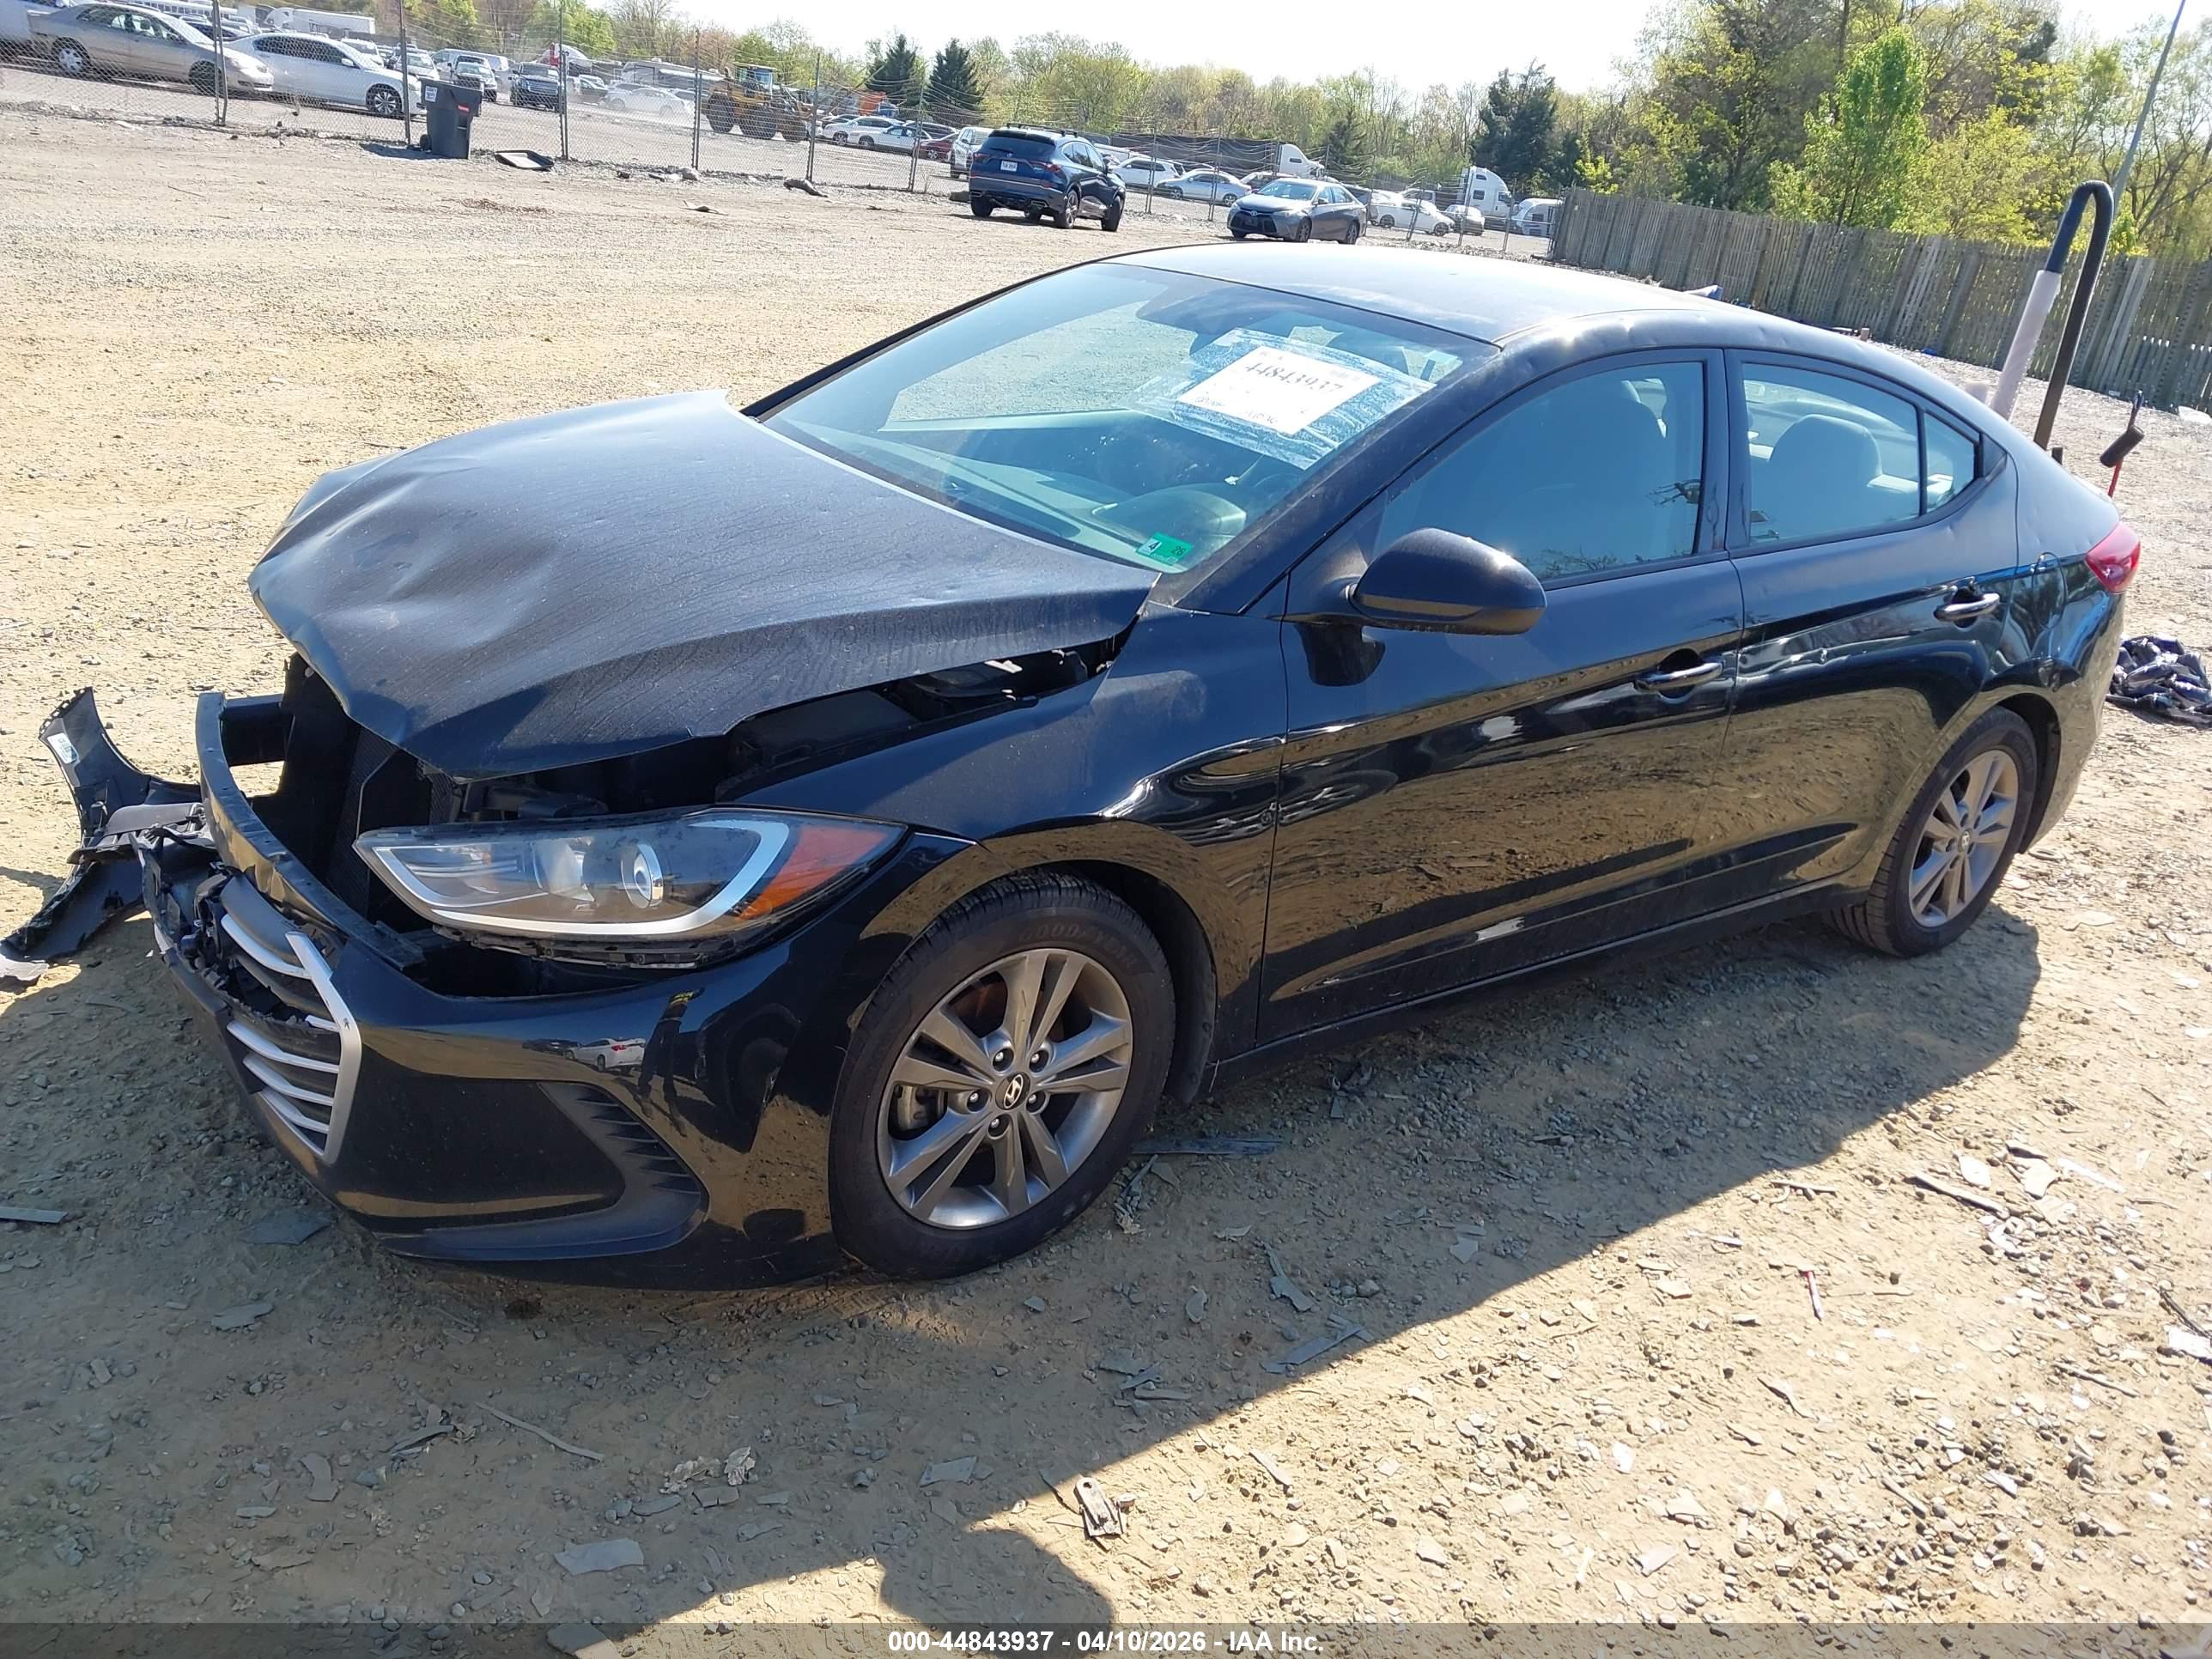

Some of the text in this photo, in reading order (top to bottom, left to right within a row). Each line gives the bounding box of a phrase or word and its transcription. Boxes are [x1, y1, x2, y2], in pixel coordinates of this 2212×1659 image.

[1245, 362, 1345, 392] 44843937
[1147, 541, 1187, 556] 4 26
